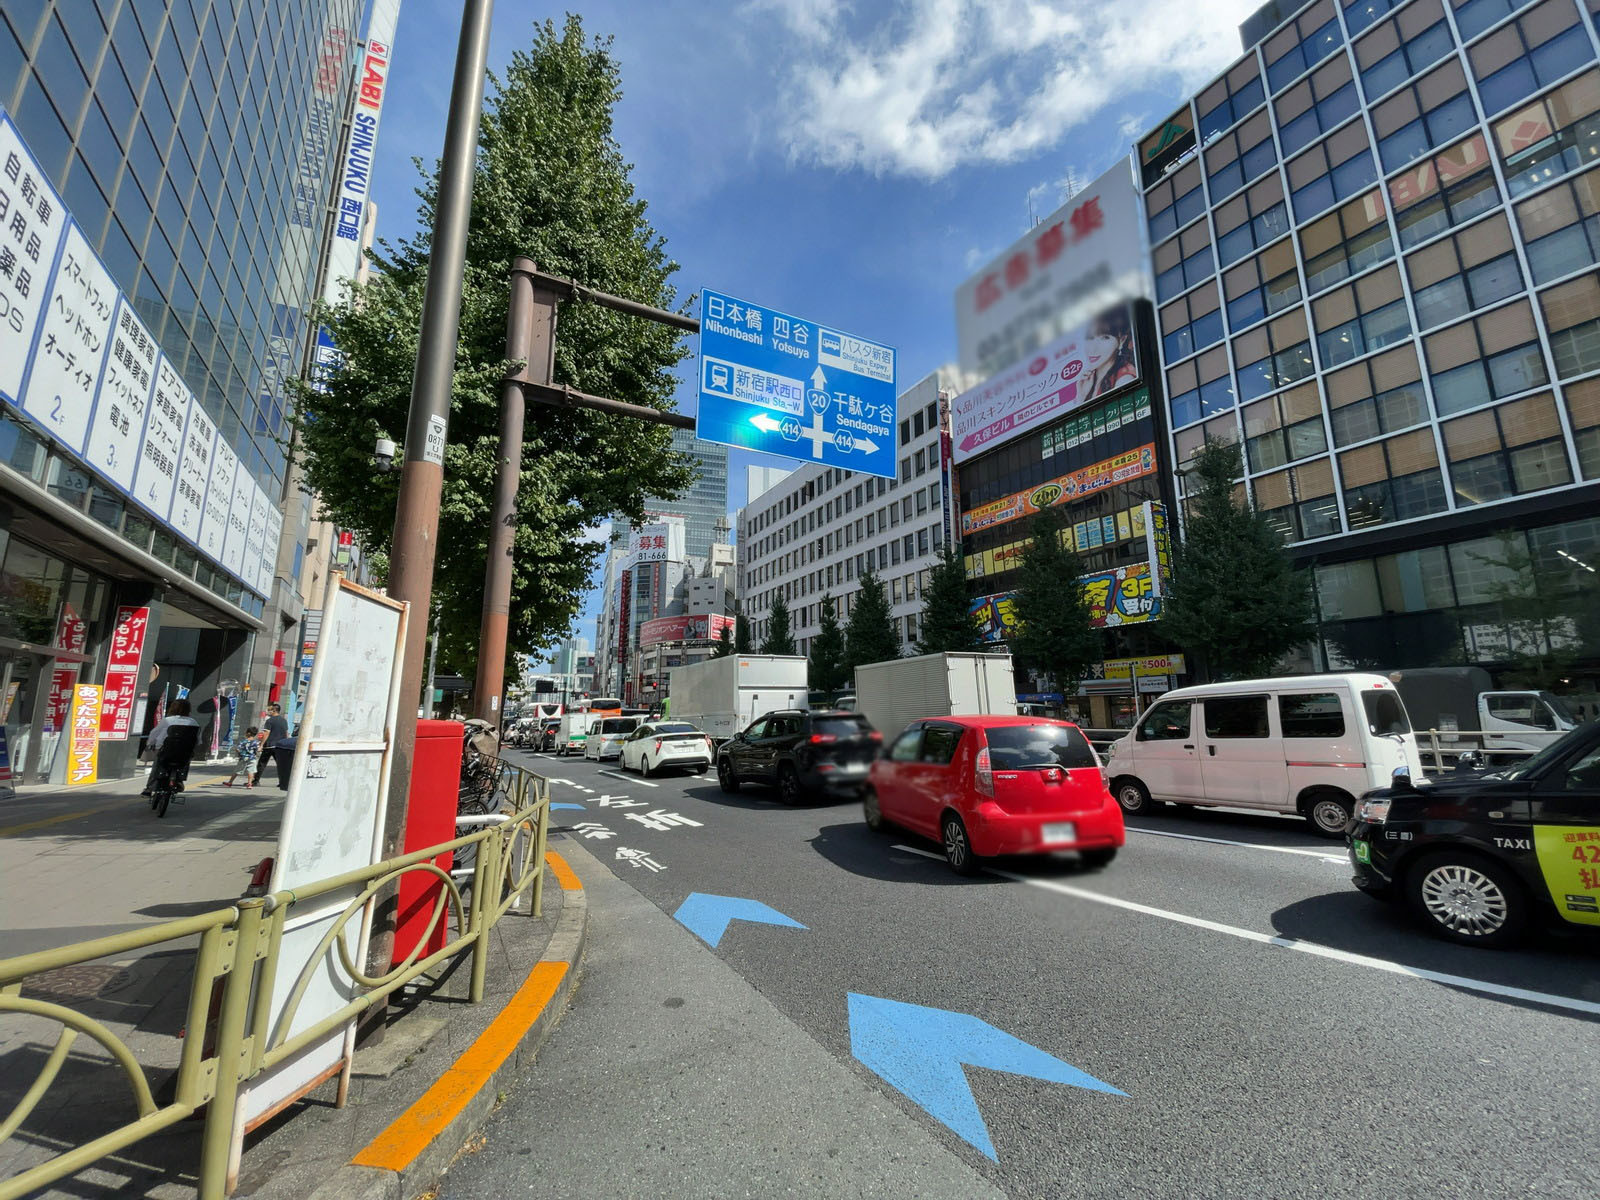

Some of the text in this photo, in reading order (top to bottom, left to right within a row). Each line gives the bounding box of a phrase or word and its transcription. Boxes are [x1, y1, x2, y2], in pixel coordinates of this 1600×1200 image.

[336, 54, 387, 242] LABI SHINJUKU 西口館
[4, 150, 52, 228] 自転車
[64, 252, 111, 322] スマートフォン
[55, 293, 101, 353] ヘッドホン
[120, 307, 155, 366] 調理家電
[705, 318, 810, 360] Nihonbashi Yotsuya
[708, 295, 809, 346] 日本橋 四谷
[44, 332, 93, 393] オーディオ
[841, 352, 869, 367] Shinjuku
[842, 338, 892, 365] バスタ新宿
[160, 364, 189, 405] エアコン
[736, 369, 803, 402] 新宿駅西口
[853, 363, 891, 381] Bus Terminal
[108, 366, 145, 419] フィットネス
[735, 387, 771, 406] Shinjuku
[811, 394, 826, 410] 20
[956, 361, 1083, 436] 品川スキンクリニック B2F
[110, 403, 131, 438] 電池
[150, 413, 178, 456] リフォーム
[782, 422, 799, 435] 414
[836, 413, 890, 437] Sendagaya
[973, 418, 1011, 446] 久保ビル
[836, 433, 852, 447] 414
[144, 439, 175, 481] 照明器具
[639, 534, 668, 551] 募集
[1121, 577, 1153, 598] 3F
[1121, 598, 1154, 616] 受付
[114, 610, 133, 660] おもちゃ
[127, 617, 146, 655] ゲーム
[102, 689, 120, 716] 時計
[113, 674, 137, 730] ゴルフ用品
[72, 686, 99, 782] あったか暖房フェア
[1493, 837, 1531, 850] TAXI
